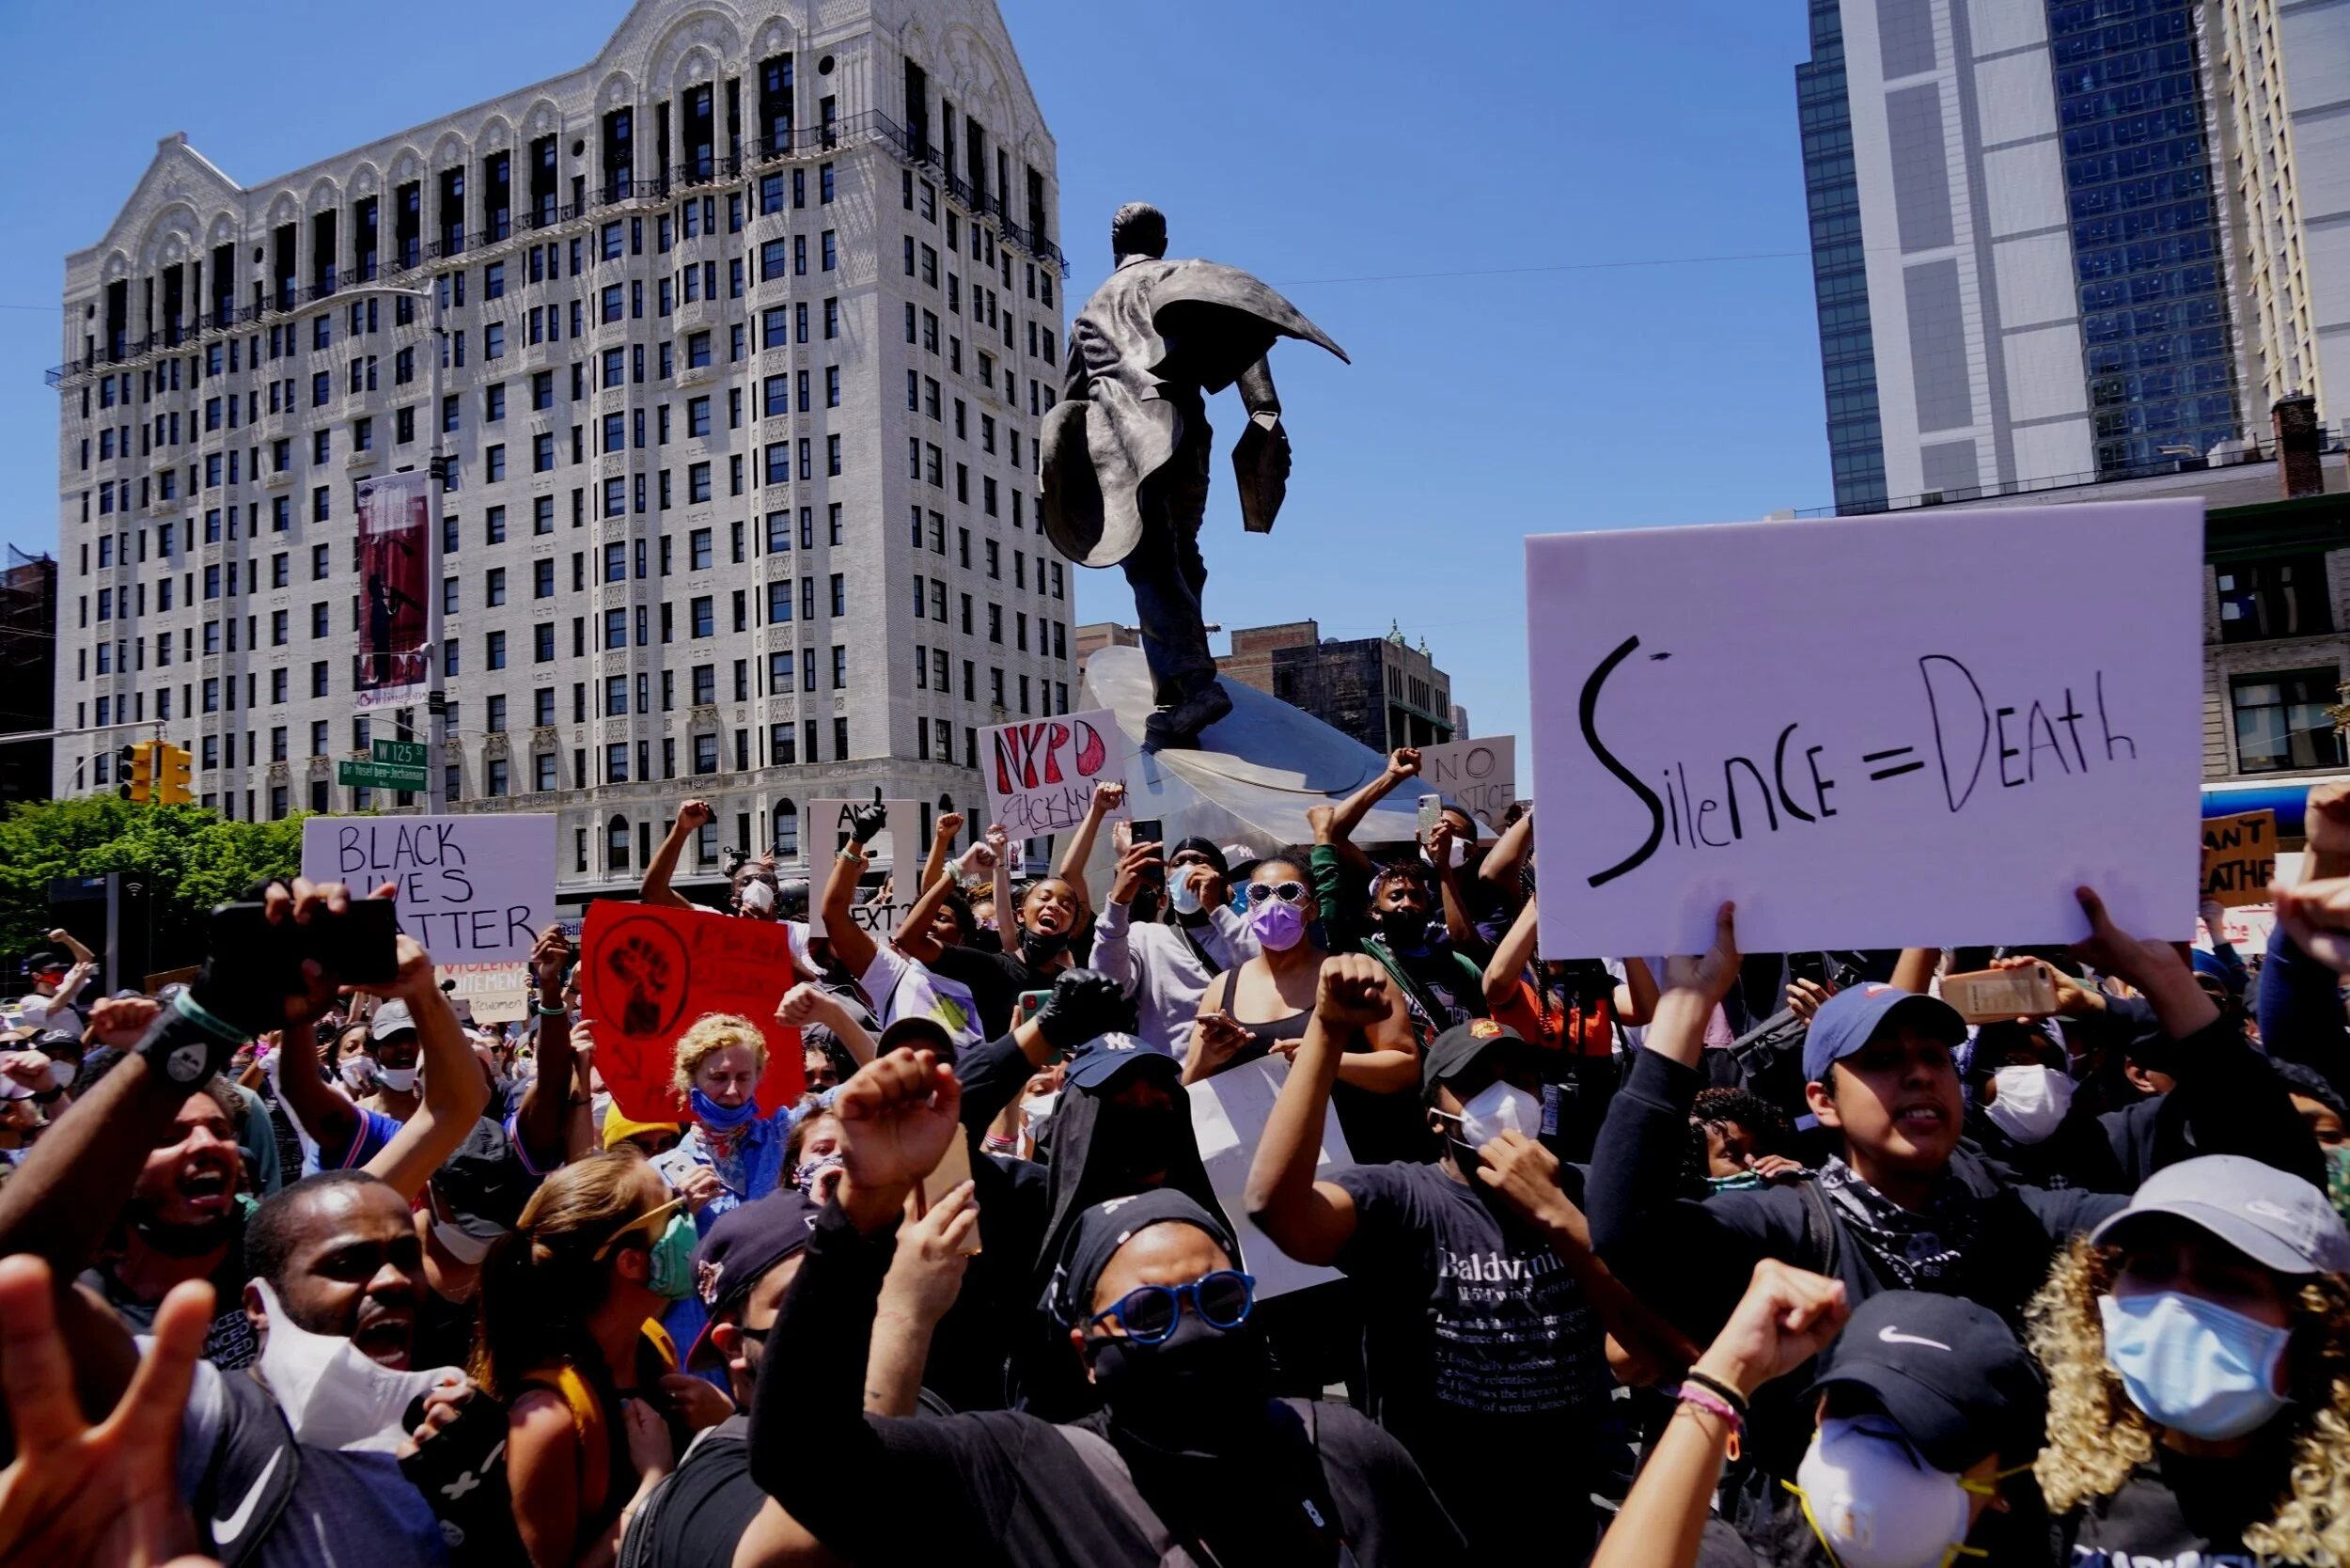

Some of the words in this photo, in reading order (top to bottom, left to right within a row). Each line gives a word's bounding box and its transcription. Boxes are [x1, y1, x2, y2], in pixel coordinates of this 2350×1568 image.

[342, 762, 352, 775] Dr
[378, 743, 388, 760] W
[393, 744, 413, 762] 125
[994, 719, 1106, 794] NYPD
[1435, 747, 1496, 782] NO
[1453, 783, 1515, 811] STICE
[339, 823, 466, 872] BLACK
[2202, 818, 2267, 852] AN'T
[342, 869, 474, 903] IVES
[2201, 859, 2276, 895] ATHE
[396, 905, 540, 949] TTER
[560, 921, 583, 936] astl
[852, 903, 912, 931] EXT
